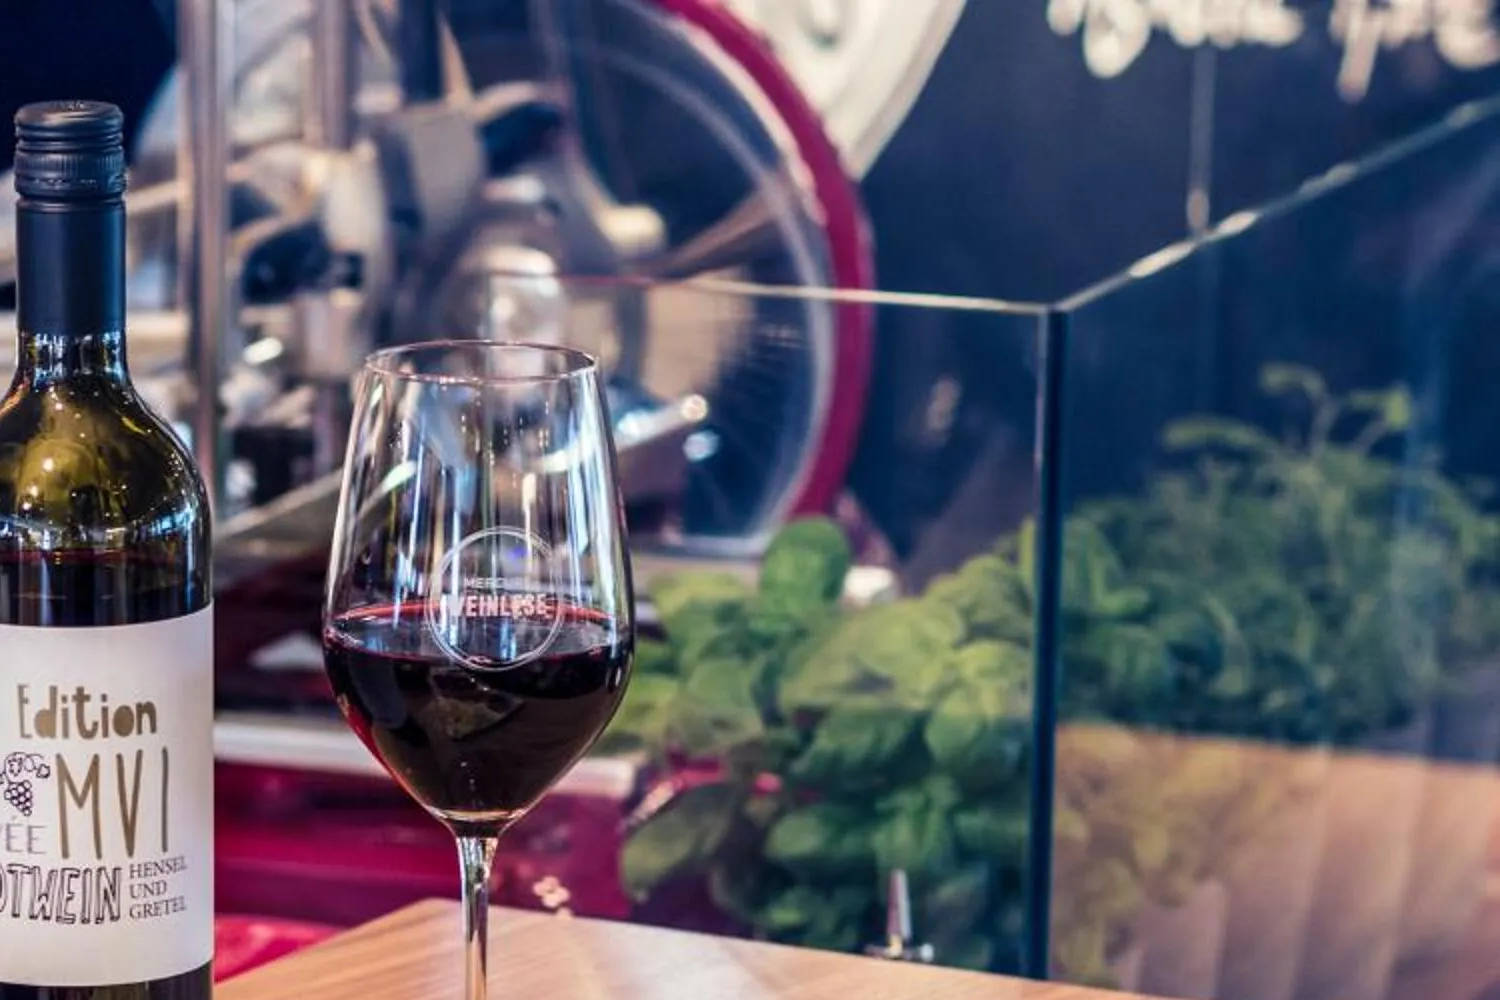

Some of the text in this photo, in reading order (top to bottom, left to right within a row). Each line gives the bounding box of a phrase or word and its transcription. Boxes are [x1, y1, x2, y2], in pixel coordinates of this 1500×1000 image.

[17, 683, 158, 740] Edition
[55, 746, 169, 860] MVI
[129, 855, 187, 879] HENSEL
[129, 879, 168, 899] UND
[129, 895, 187, 919] GRETEL
